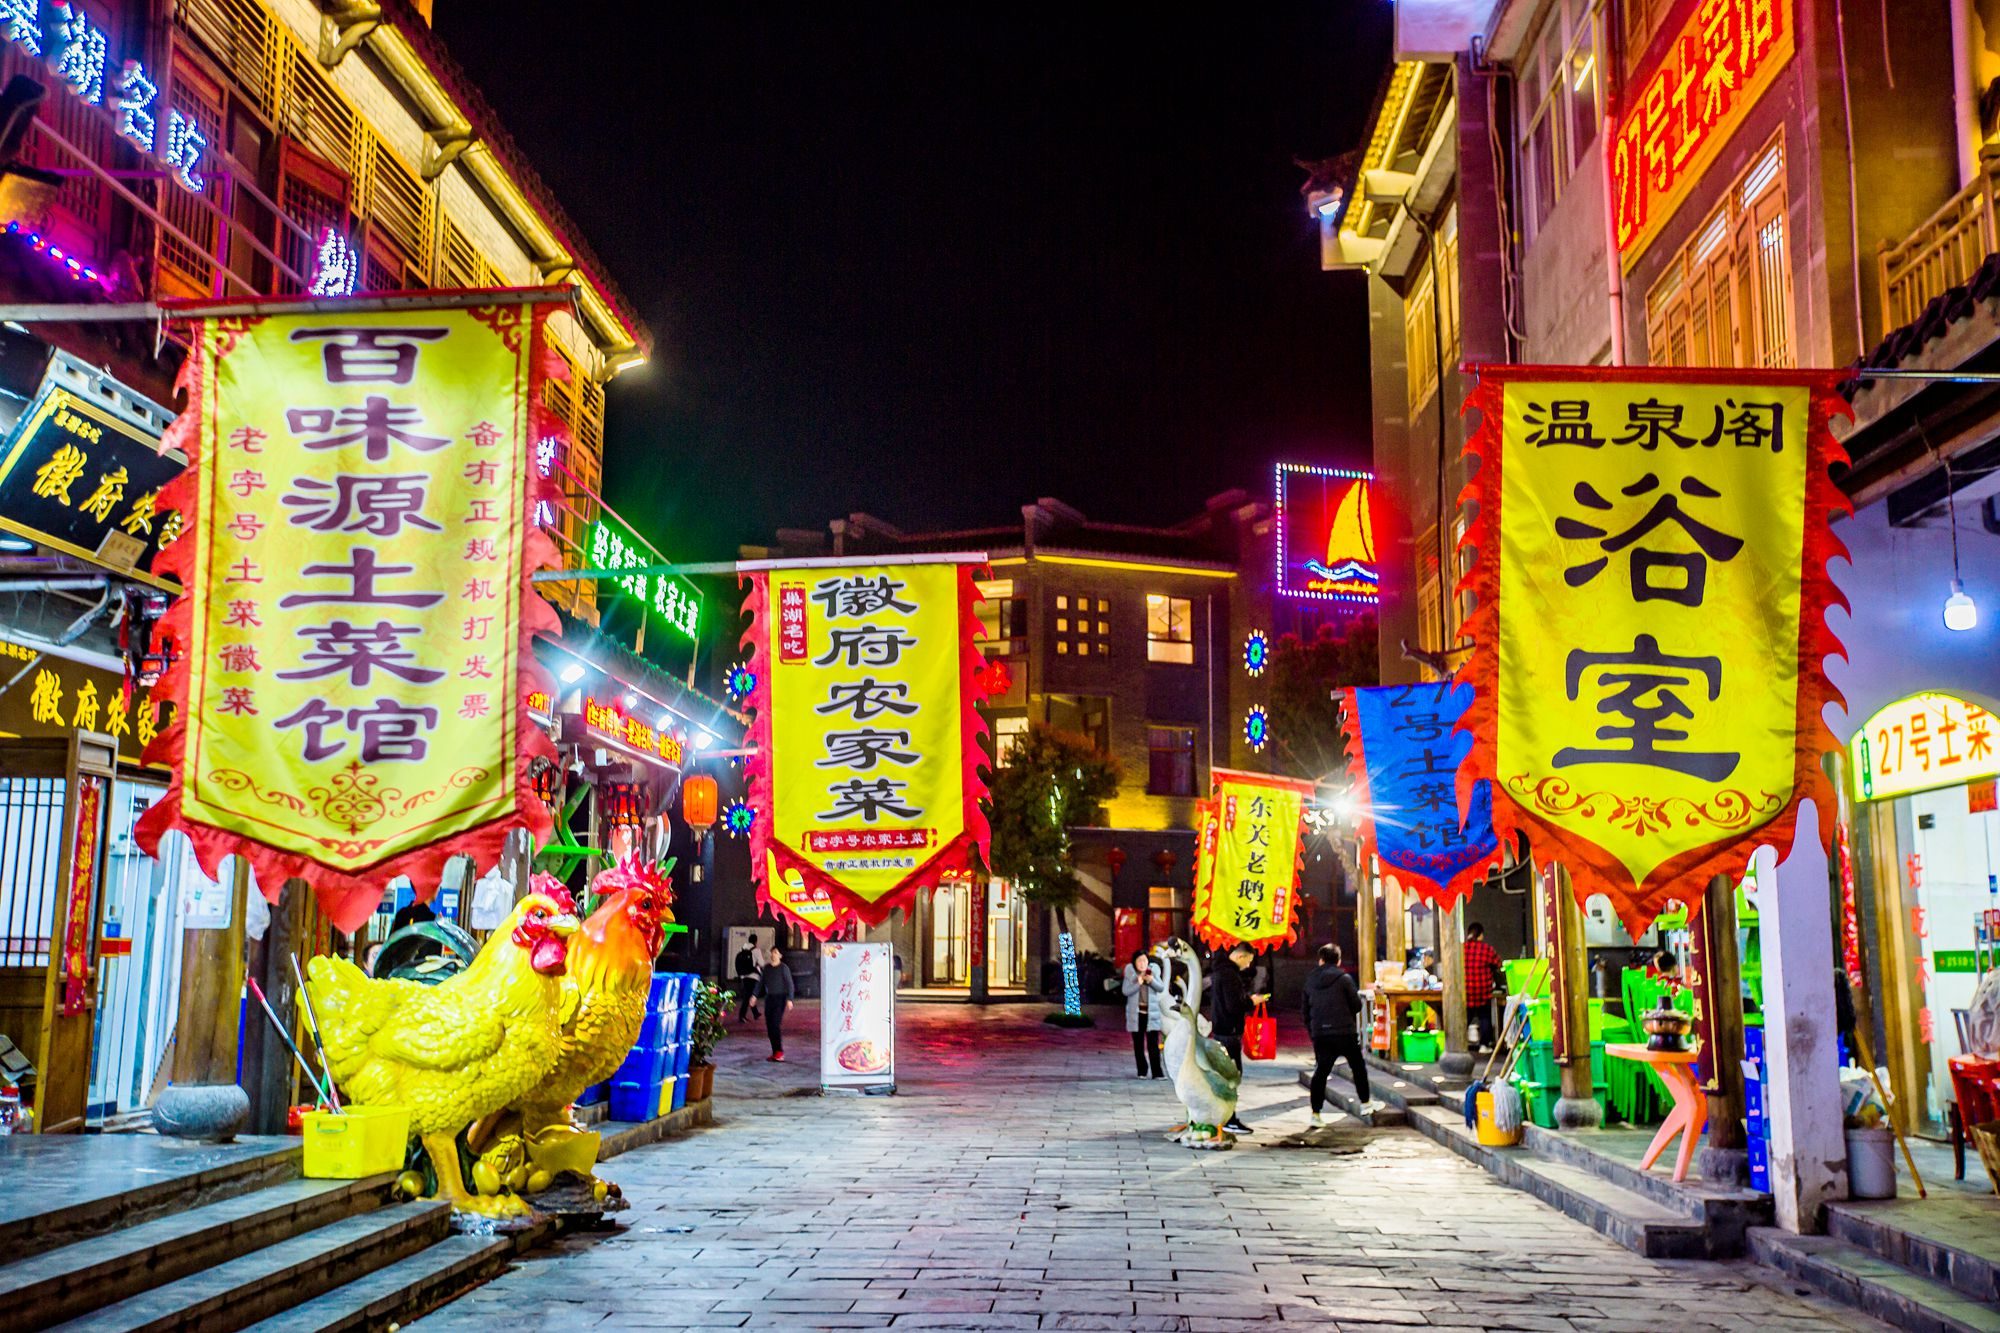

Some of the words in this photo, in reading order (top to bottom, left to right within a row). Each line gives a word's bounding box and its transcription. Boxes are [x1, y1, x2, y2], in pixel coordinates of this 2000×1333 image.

[274, 327, 453, 763] 百味源土菜馆
[1523, 398, 1785, 452] 温泉阁
[216, 426, 268, 718] 老字号土菜徽菜
[458, 421, 504, 719] 备有正规机打发票
[812, 576, 924, 822] 徽府农家菜
[1552, 473, 1745, 782] 浴室
[1234, 796, 1274, 930] 东关老鹅汤
[1907, 854, 1935, 1045] 好吃不贵
